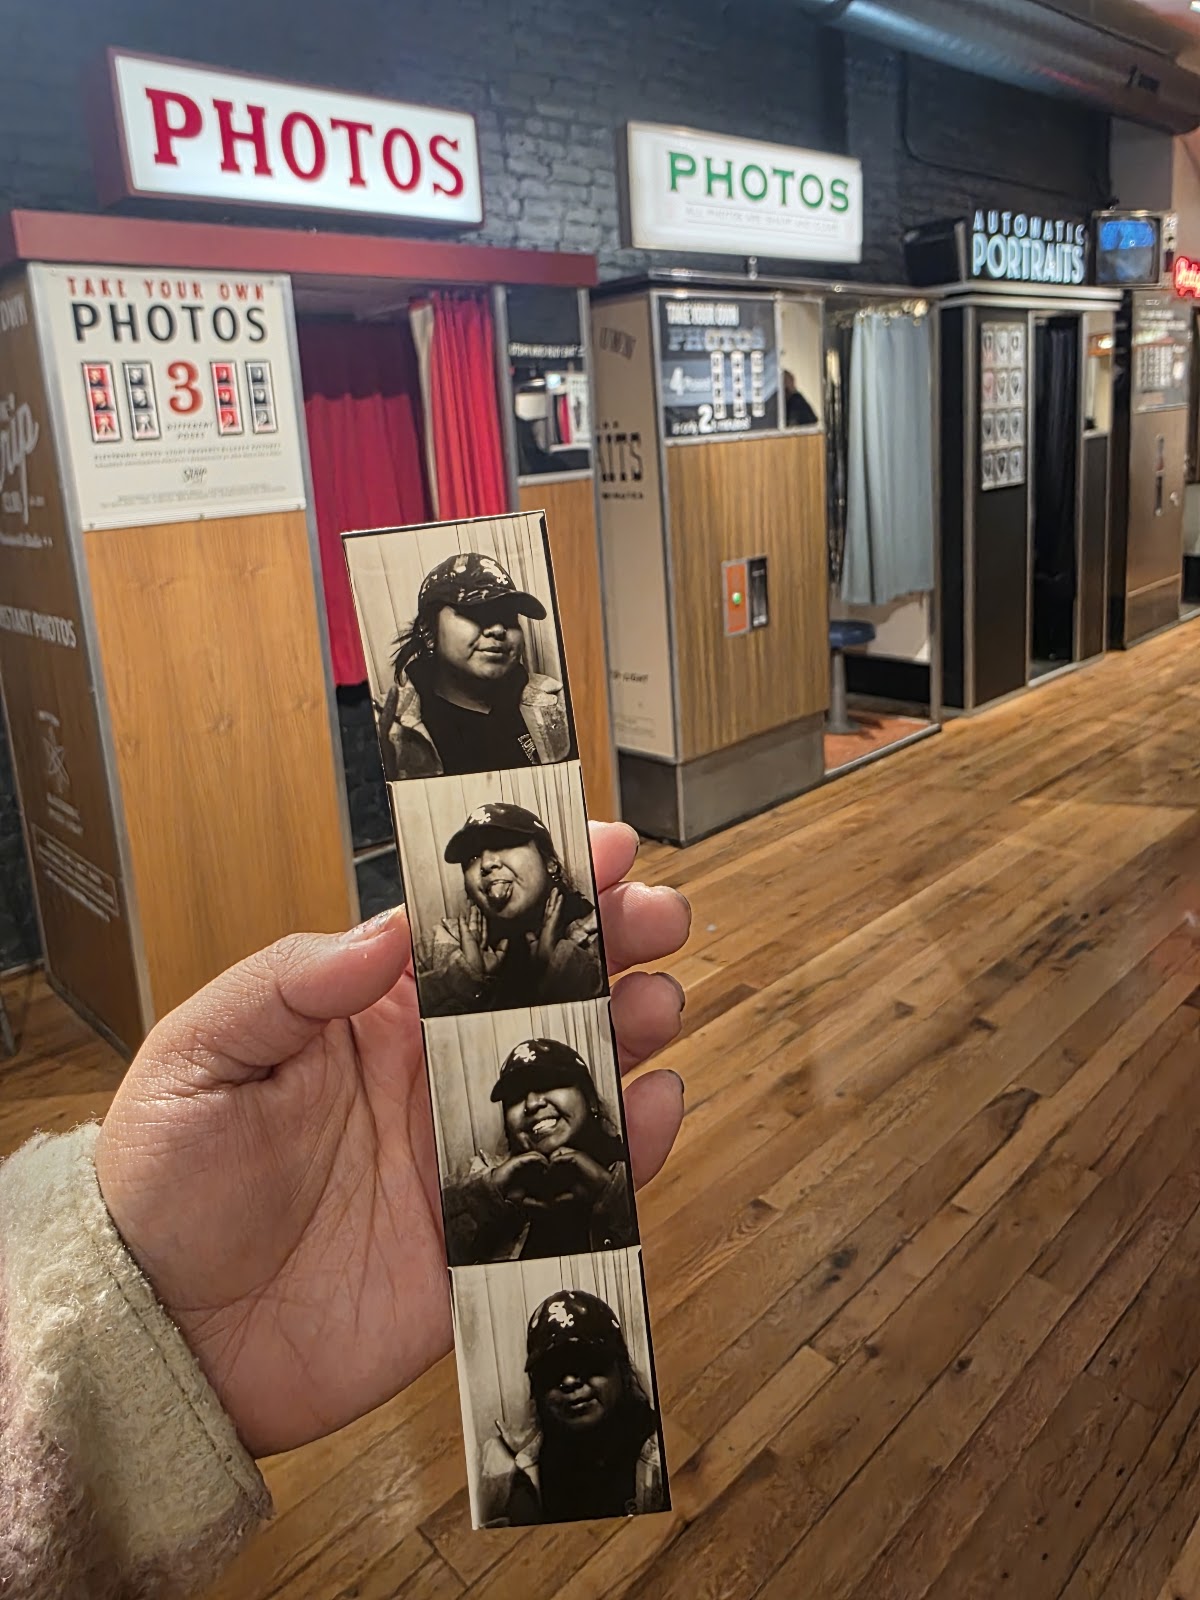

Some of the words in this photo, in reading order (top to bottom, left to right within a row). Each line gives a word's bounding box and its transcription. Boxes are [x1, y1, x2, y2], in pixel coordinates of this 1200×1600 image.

[145, 87, 464, 199] PHOTOS
[668, 151, 849, 212] PHOTOS
[973, 209, 1085, 246] AUTOMATIC
[973, 233, 1085, 284] PORTRAITS
[67, 277, 127, 297] TAKE
[144, 280, 203, 299] YOUR
[219, 281, 265, 301] OWN
[71, 303, 267, 343] PHOTOS
[167, 361, 203, 415] 3
[670, 367, 684, 396] 4
[698, 403, 713, 434] 2
[33, 610, 77, 648] PHOTOS
